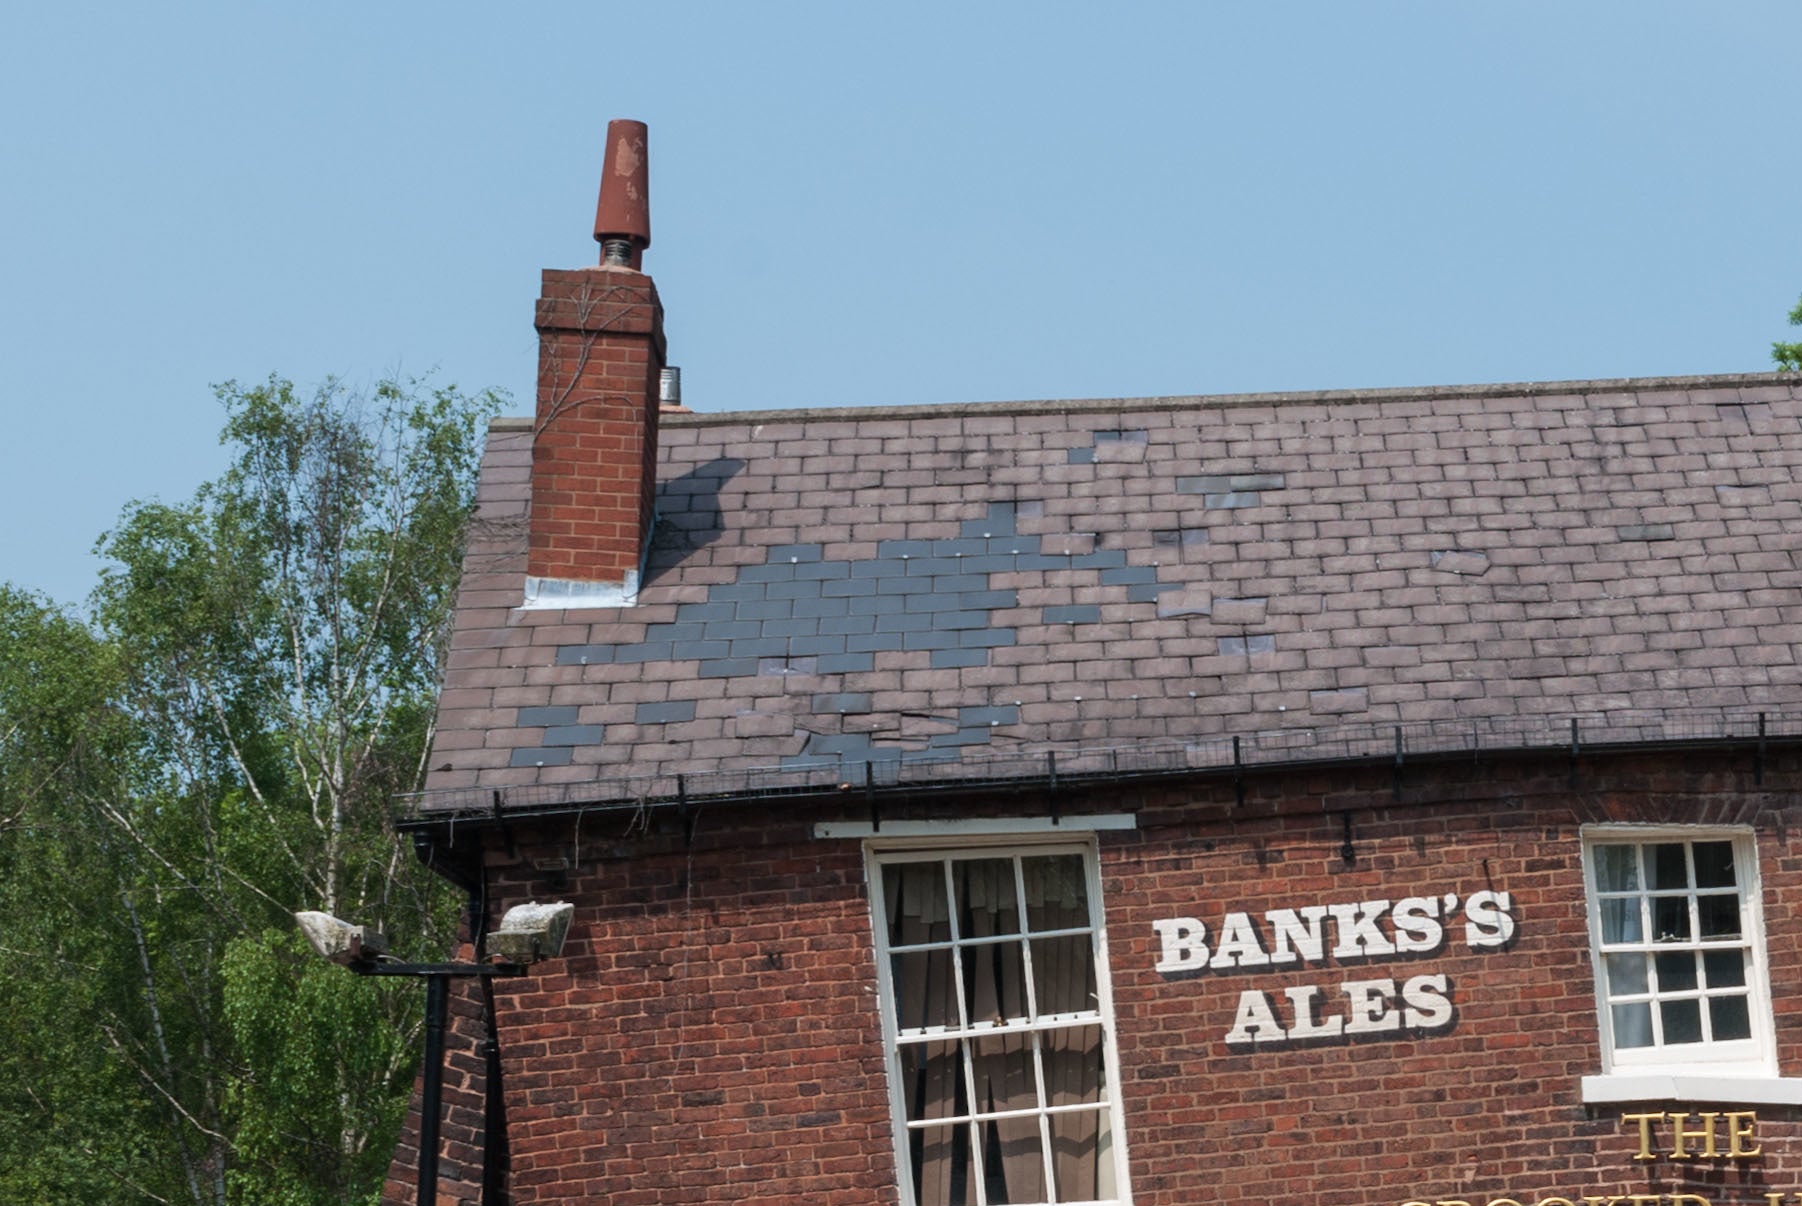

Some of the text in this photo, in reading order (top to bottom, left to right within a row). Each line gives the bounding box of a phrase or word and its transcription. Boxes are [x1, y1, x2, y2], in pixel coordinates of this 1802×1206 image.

[1152, 890, 1514, 973] BANKS'S
[1224, 974, 1453, 1044] ALES
[1621, 1111, 1761, 1160] THE
